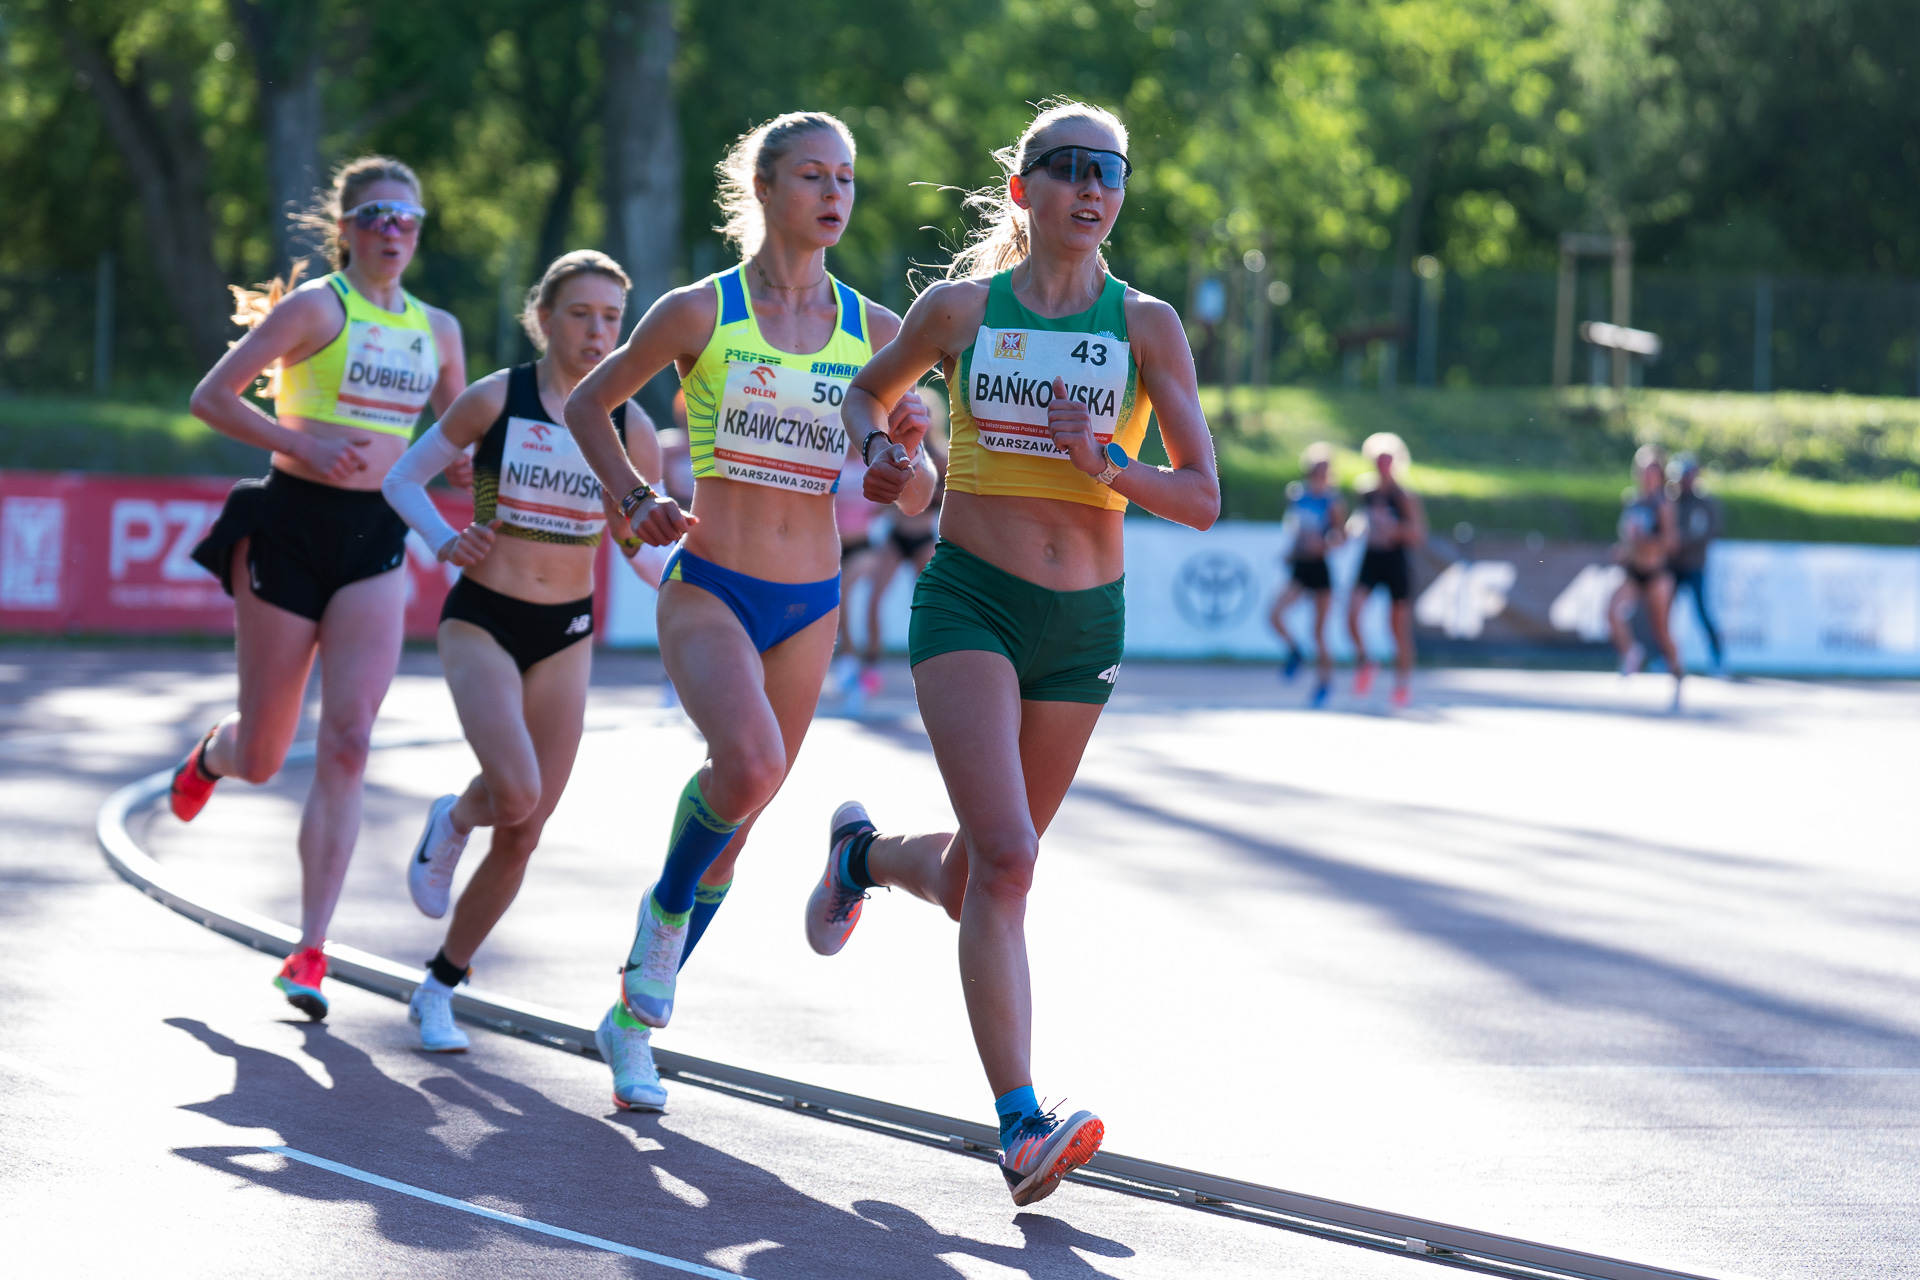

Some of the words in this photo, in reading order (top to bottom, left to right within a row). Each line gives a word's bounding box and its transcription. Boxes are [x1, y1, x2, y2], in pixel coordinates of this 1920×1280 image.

[410, 338, 422, 354] 4
[1071, 341, 1107, 366] 43
[743, 386, 776, 399] ORLEN
[811, 382, 843, 406] 50
[723, 408, 845, 455] KRAWCZYŃSKA
[985, 436, 1062, 454] WARSZAWA
[506, 462, 602, 500] NIEMYJSK
[728, 465, 797, 487] WARSZAWA
[799, 478, 827, 492] 2025
[510, 511, 571, 530] WARSZAWA
[1413, 559, 1518, 640] 4F
